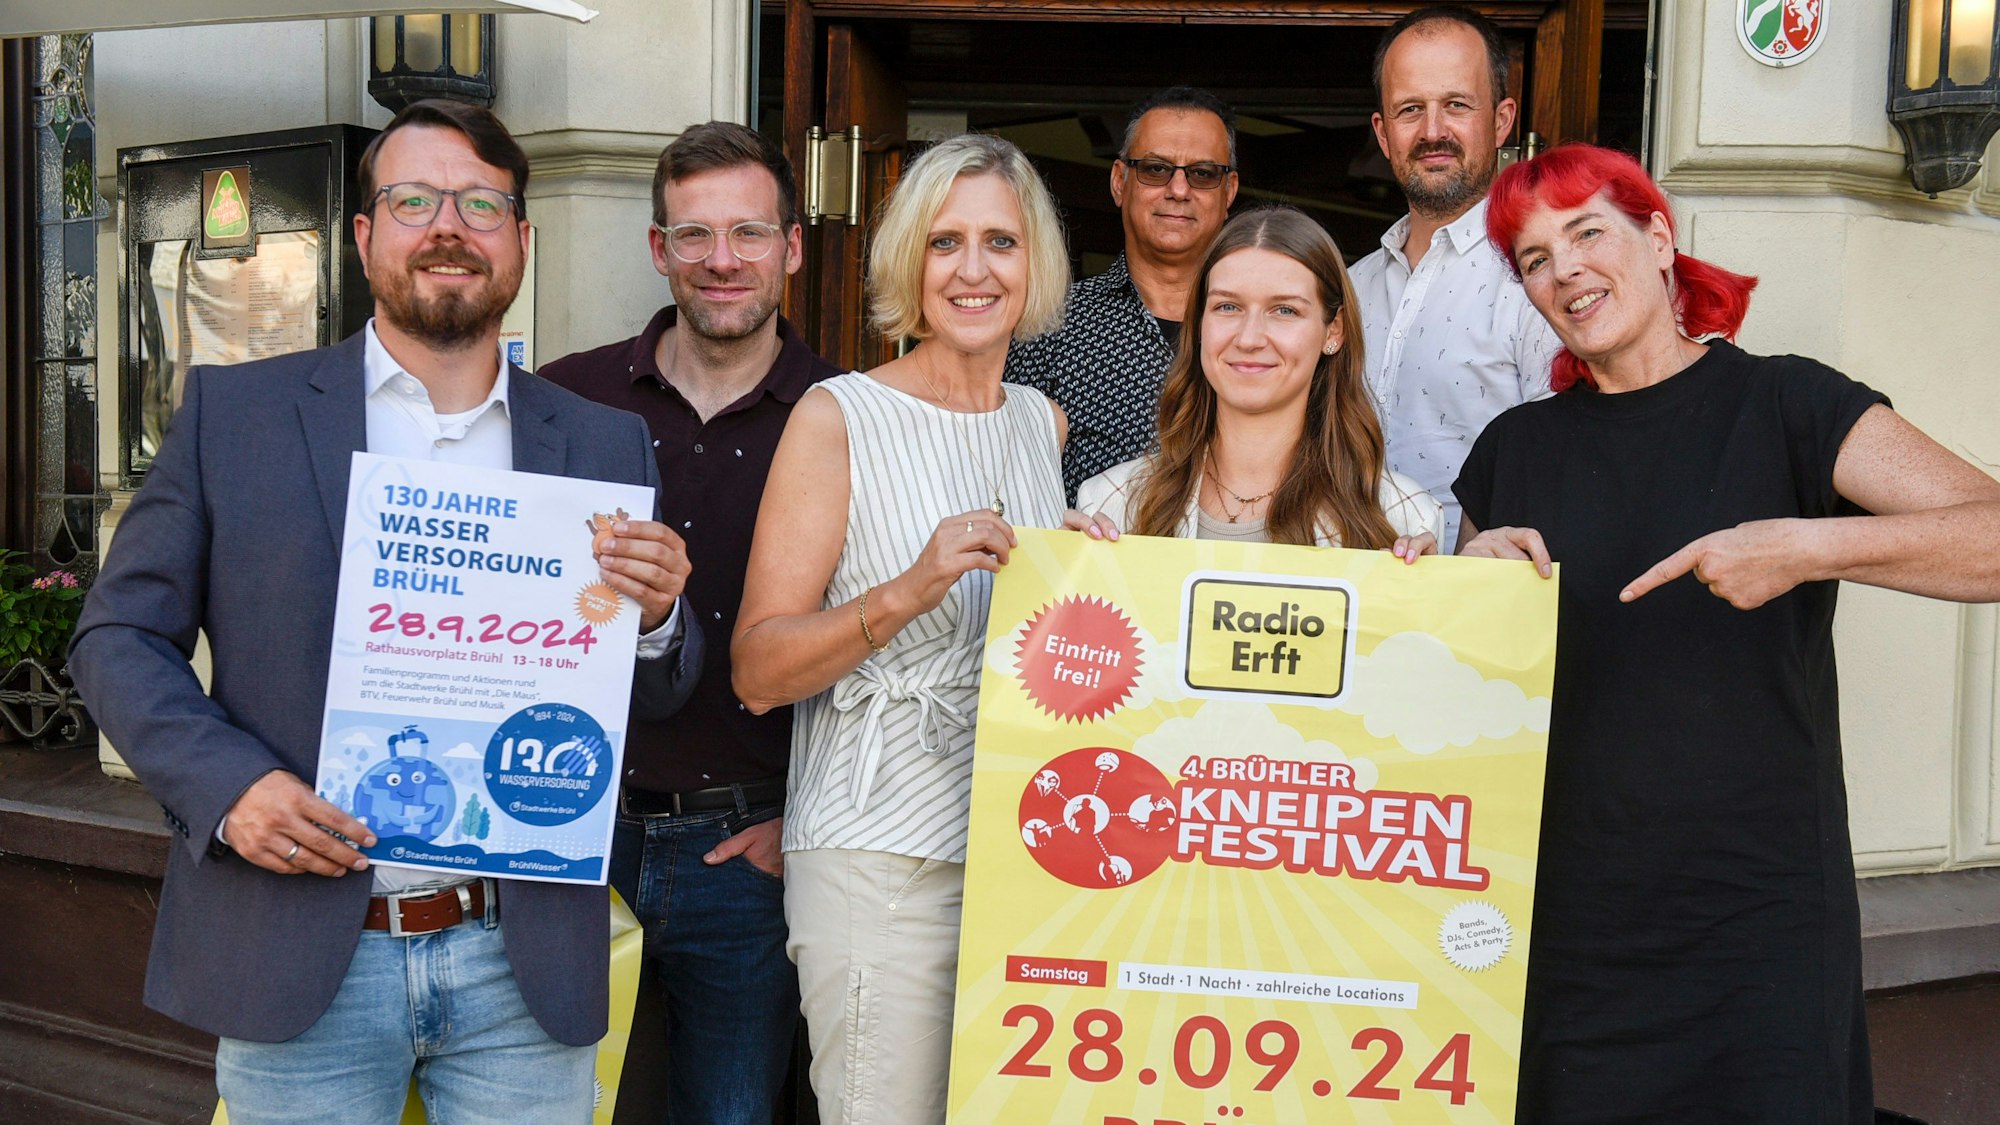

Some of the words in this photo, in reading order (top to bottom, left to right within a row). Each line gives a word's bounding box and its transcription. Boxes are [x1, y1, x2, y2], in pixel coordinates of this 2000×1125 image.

[384, 485, 428, 508] 130
[431, 490, 518, 519] JAHRE
[379, 512, 490, 543] WASSER
[376, 540, 562, 578] VERSORGUNG
[372, 568, 464, 596] BRÜHL
[368, 603, 597, 655] 28.9.2024
[1212, 600, 1325, 639] Radio
[366, 641, 467, 662] Rathausvorplatz
[470, 651, 503, 664] Brühl
[513, 656, 526, 666] 13
[538, 657, 552, 668] 18
[556, 658, 580, 670] Uhr
[1045, 634, 1121, 668] Eintritt
[1231, 641, 1301, 676] Erft
[363, 666, 450, 681] Familienprogramm
[452, 672, 470, 682] und
[472, 675, 512, 686] Aktionen
[514, 679, 536, 688] rund
[379, 679, 394, 688] die
[396, 680, 446, 694] Stadtwerke
[450, 684, 473, 696] Brühl
[476, 688, 490, 698] mit
[1054, 661, 1101, 688] frei!
[382, 692, 431, 704] Feuerwehr
[433, 695, 457, 706] Brühl
[459, 698, 477, 708] und
[479, 700, 505, 710] Musik
[556, 711, 576, 723] 2024
[500, 774, 591, 790] WASSERVERSORGUNG
[1182, 759, 1204, 779] 4.
[1211, 757, 1352, 788] BRÜHLER
[520, 804, 558, 814] Stadtwerke
[560, 806, 576, 814] Brühl
[1180, 787, 1466, 840] KNEIPEN
[404, 850, 454, 864] Stadtwerke
[454, 853, 478, 865] Brühl
[508, 860, 561, 872] BrühlWasser
[1177, 823, 1483, 883] FESTIVAL
[1447, 934, 1464, 942] DJs,
[1466, 926, 1504, 938] Comedy,
[1459, 918, 1487, 930] Bands,
[1454, 943, 1472, 952] Acts
[1482, 937, 1504, 946] Party
[1020, 963, 1089, 984] Samstag
[1125, 971, 1132, 984] 1
[1138, 971, 1175, 986] Stadt
[1199, 976, 1242, 990] Nacht
[1256, 979, 1332, 998] zahlreiche
[1336, 984, 1406, 1003] Locations
[997, 1004, 1475, 1106] 28.09.24
